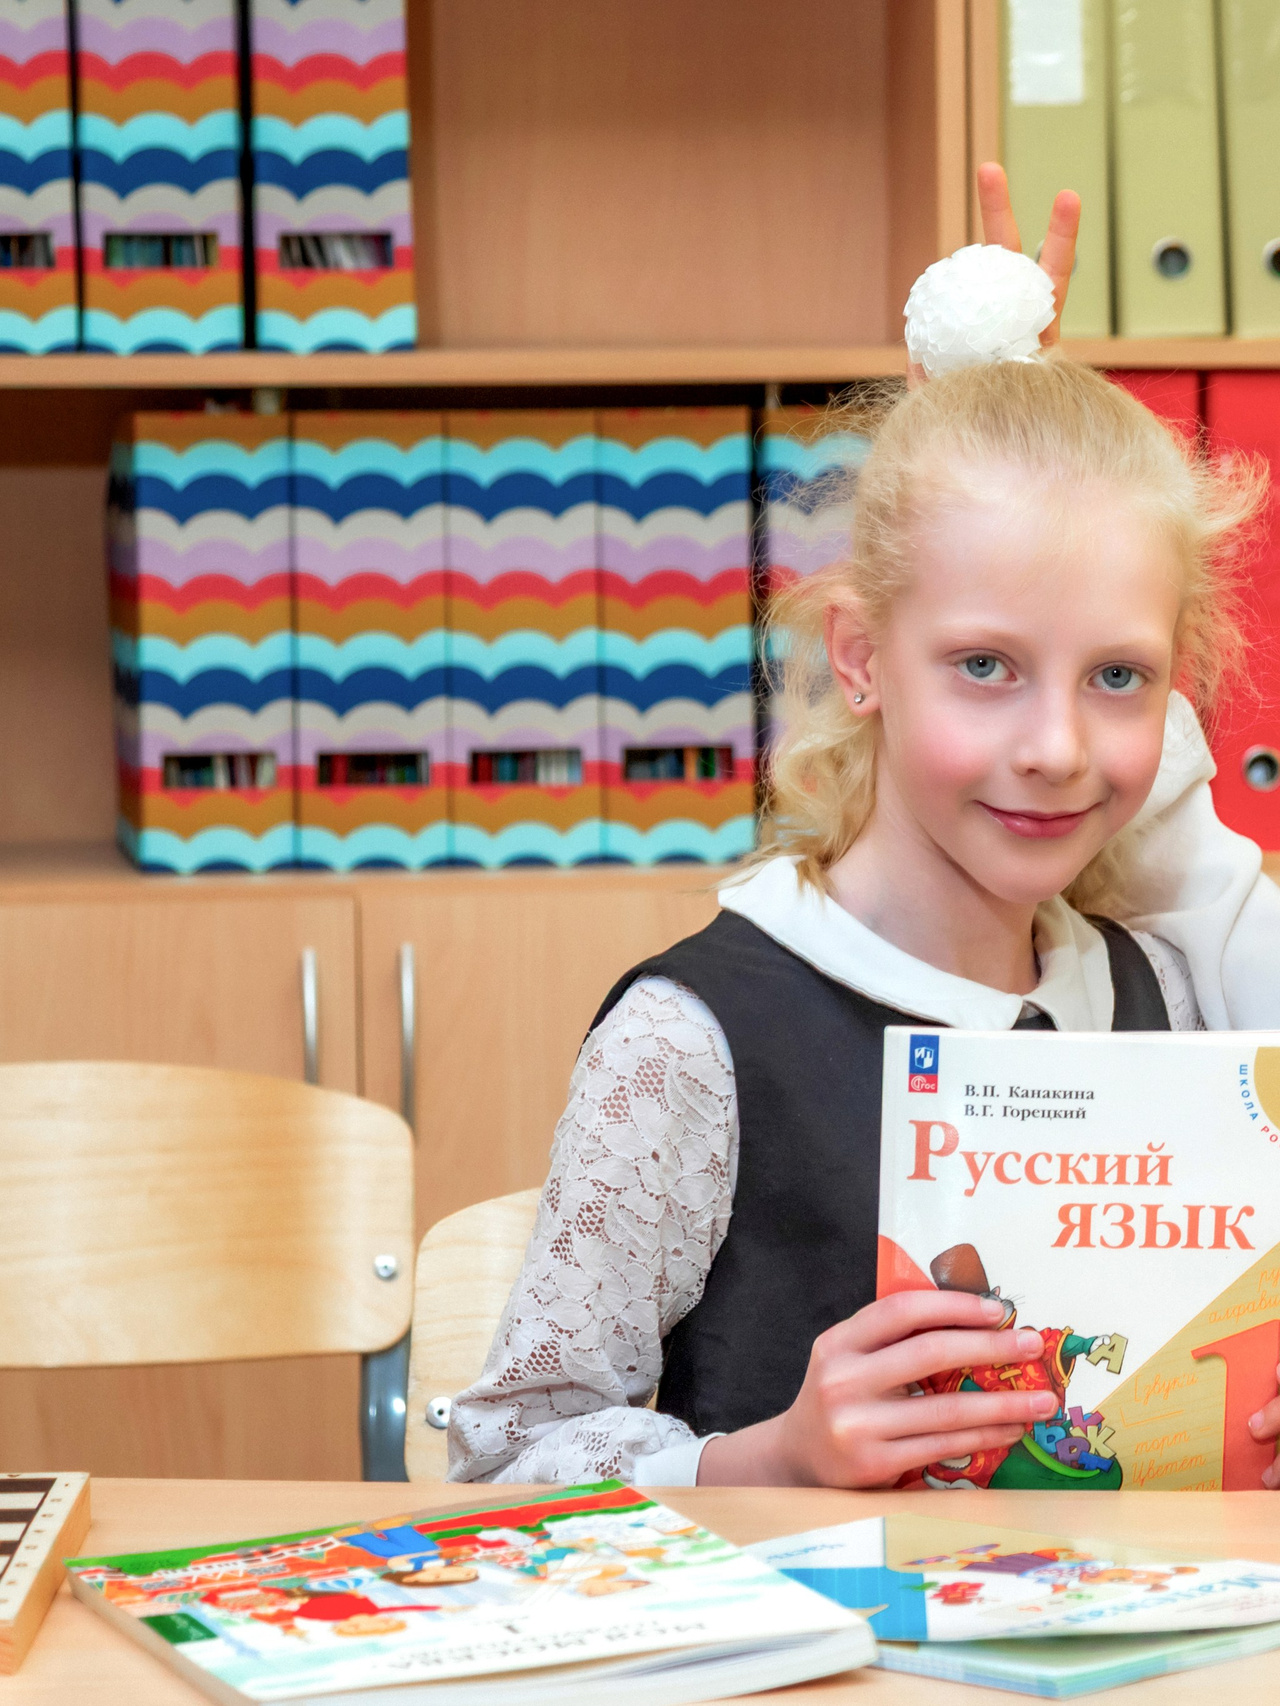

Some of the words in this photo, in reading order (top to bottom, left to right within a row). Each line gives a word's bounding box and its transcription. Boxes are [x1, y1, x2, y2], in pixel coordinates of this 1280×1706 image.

[1008, 1085, 1095, 1101] Канакина
[1239, 1064, 1259, 1120] ШКОЛА
[1002, 1105, 1087, 1121] Горецкий
[907, 1119, 1174, 1197] Русский
[1135, 1430, 1190, 1456] торт
